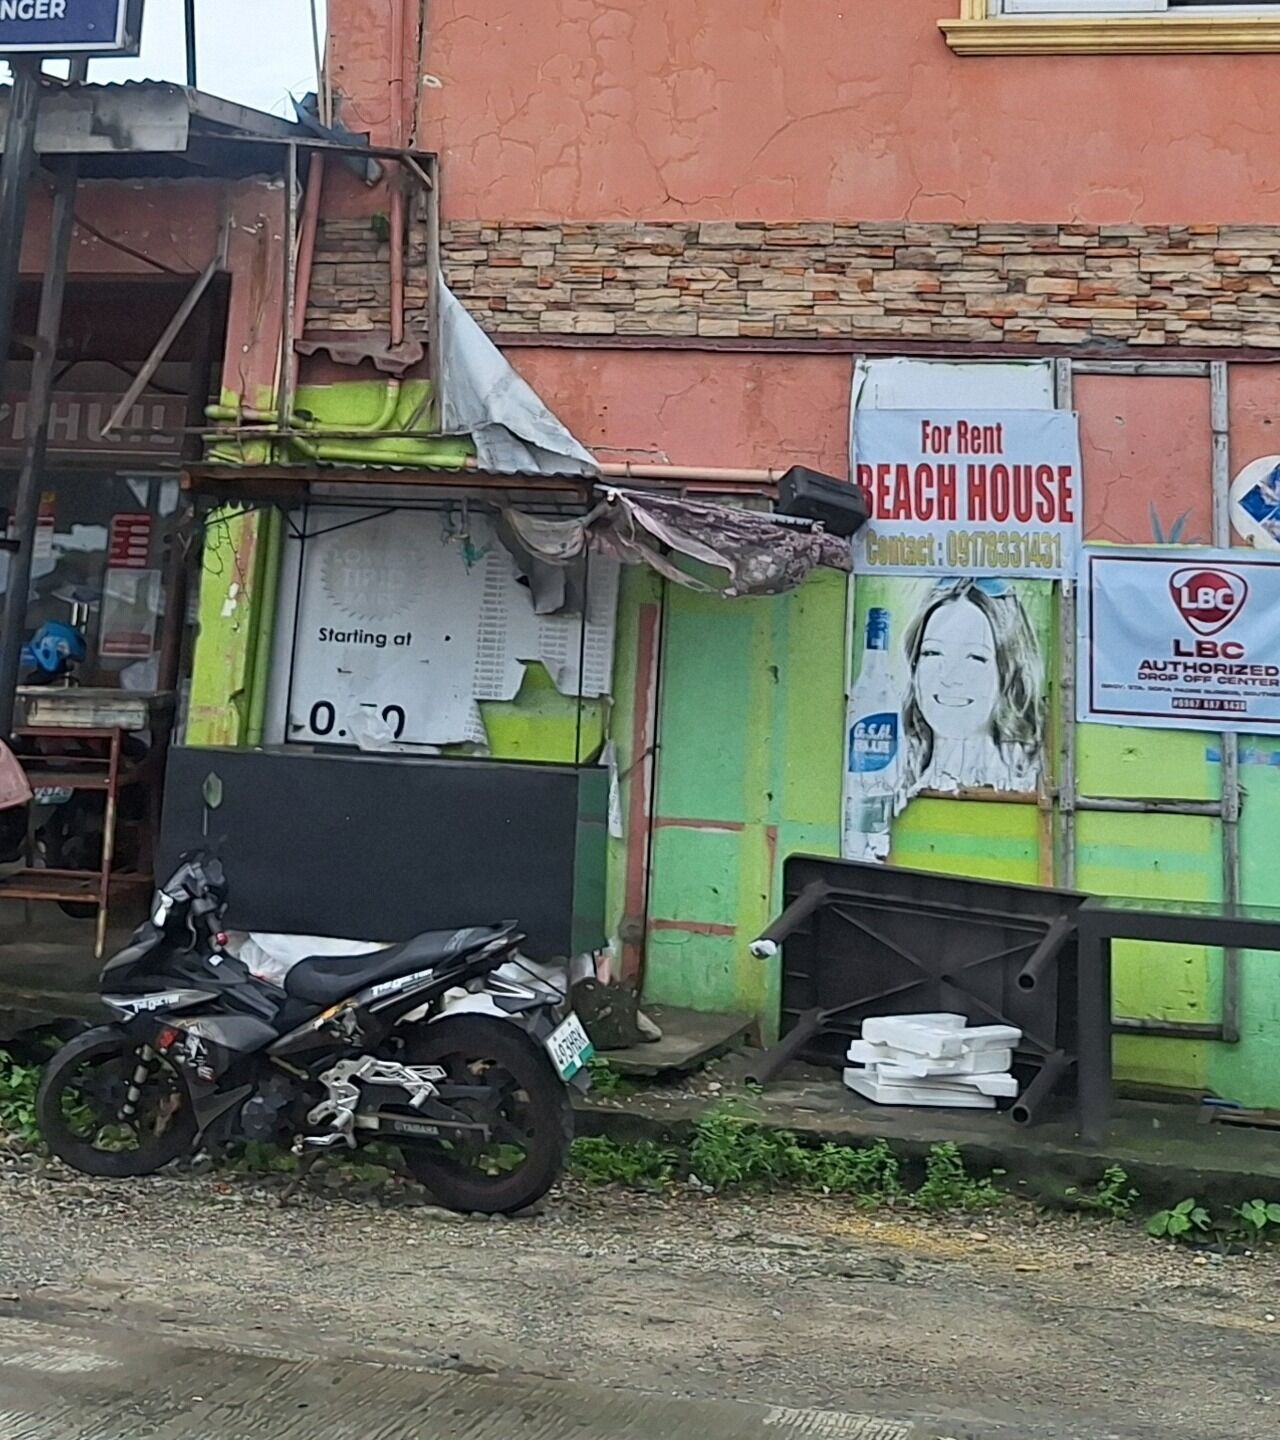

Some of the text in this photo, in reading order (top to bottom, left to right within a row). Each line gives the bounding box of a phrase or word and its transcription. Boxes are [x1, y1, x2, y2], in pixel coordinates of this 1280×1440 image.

[921, 420, 1003, 455] For Rent
[856, 463, 1074, 523] BEACH HOUSE
[1180, 587, 1236, 611] LBC
[318, 627, 412, 648] Starting at
[1173, 639, 1246, 659] LBC
[1138, 659, 1280, 677] AUTHORIZED
[1137, 672, 1280, 687] DROP OFF CENTER
